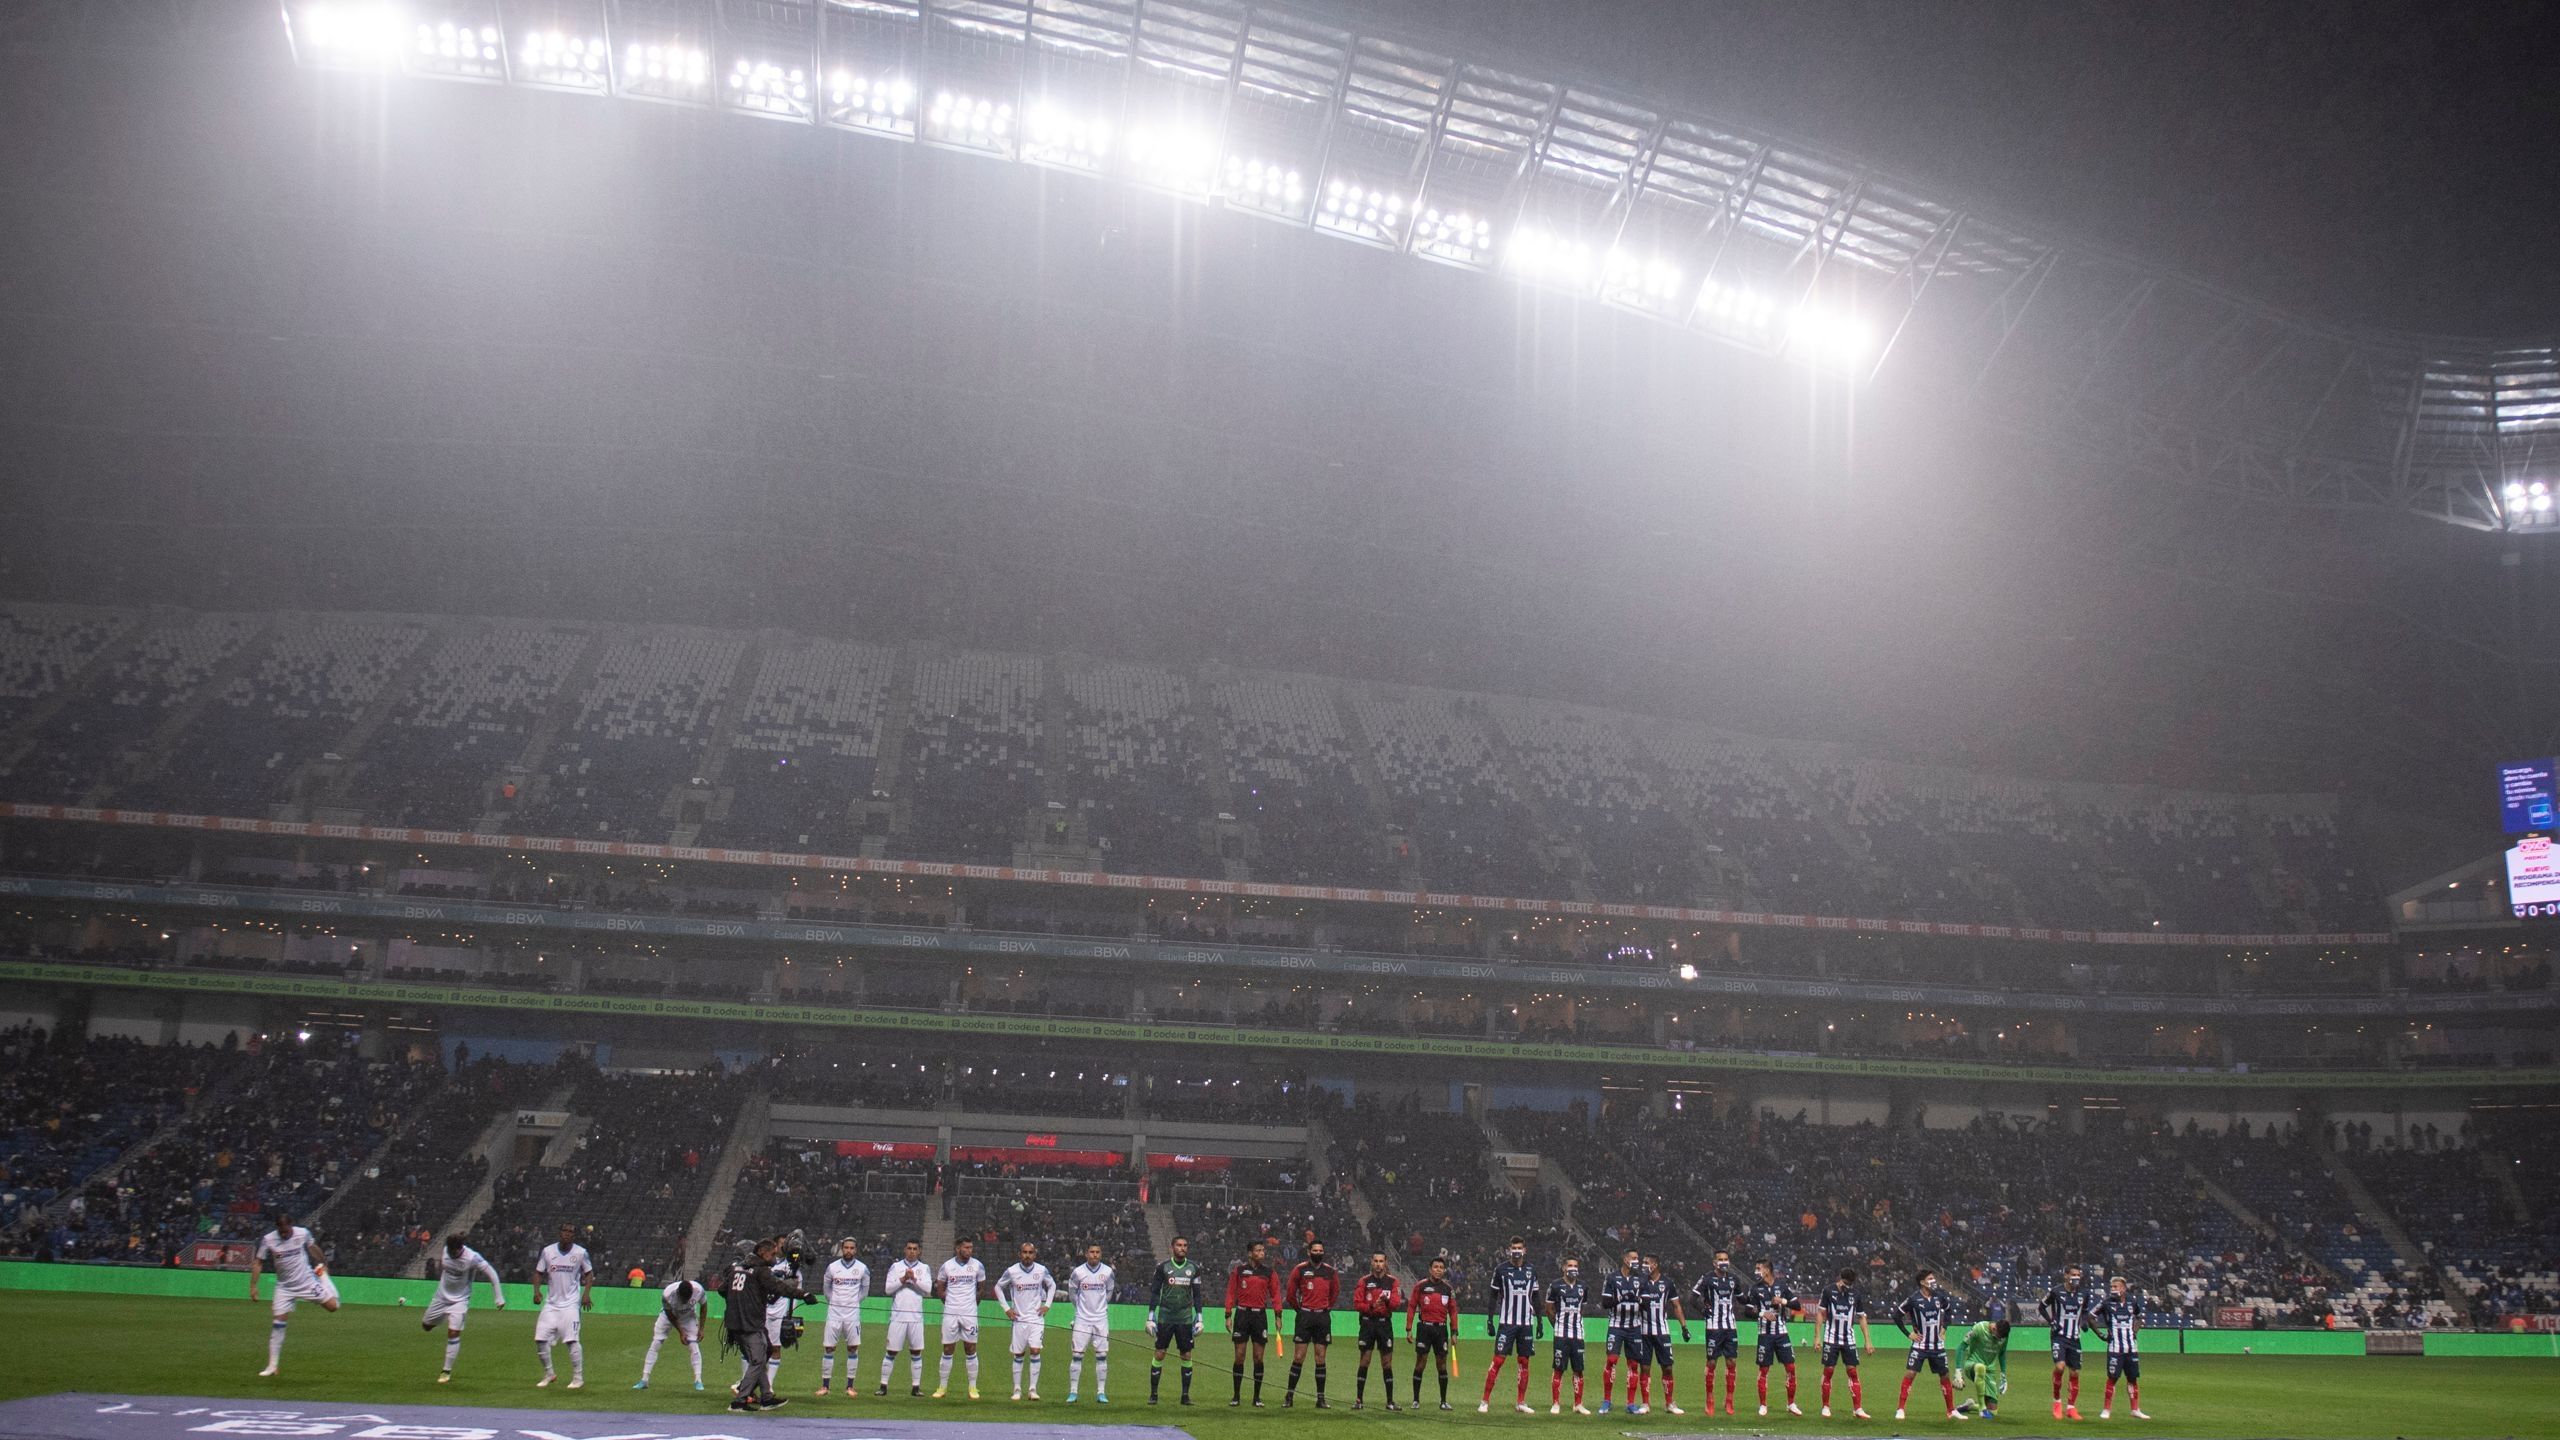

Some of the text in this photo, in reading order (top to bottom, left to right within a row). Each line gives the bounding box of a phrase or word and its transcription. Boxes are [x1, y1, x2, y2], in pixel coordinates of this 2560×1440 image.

[322, 823, 359, 838] TECATE
[372, 826, 408, 841] TECATE
[423, 829, 460, 844] TECATE
[474, 833, 510, 847] TECATE
[525, 836, 561, 850] TECATE
[574, 839, 610, 853] TECATE
[624, 842, 660, 857] TECATE
[672, 845, 708, 860] TECATE
[723, 848, 760, 862] TECATE
[771, 852, 806, 866] TECATE
[821, 855, 857, 869] TECATE
[869, 858, 904, 872] TECATE
[918, 861, 952, 875] TECATE
[964, 864, 999, 879] TECATE
[1013, 867, 1048, 882] TECATE
[1059, 869, 1093, 884] TECATE
[1107, 872, 1141, 887] TECATE
[1153, 875, 1187, 889] TECATE
[94, 887, 135, 900] BBVA
[1200, 880, 1234, 894] TECATE
[1246, 882, 1280, 896] TECATE
[1293, 885, 1326, 898] TECATE
[199, 894, 240, 906] BBVA
[1336, 887, 1370, 901] TECATE
[1384, 890, 1417, 903] TECATE
[1427, 892, 1460, 906] TECATE
[302, 900, 342, 912] BBVA
[1472, 895, 1505, 909] TECATE
[1516, 897, 1549, 911] TECATE
[1560, 900, 1593, 913] TECATE
[404, 906, 445, 919] BBVA
[1602, 903, 1635, 916] TECATE
[1647, 905, 1680, 919] TECATE
[1688, 908, 1720, 921] TECATE
[506, 913, 545, 925] BBVA
[1733, 910, 1764, 924] TECATE
[1774, 912, 1805, 926] TECATE
[1816, 915, 1848, 928] TECATE
[607, 918, 645, 931] BBVA
[706, 924, 745, 936] BBVA
[1857, 917, 1888, 931] TECATE
[1900, 920, 1931, 933] TECATE
[1939, 922, 1970, 935] TECATE
[1981, 924, 2011, 937] TECATE
[804, 929, 843, 942] BBVA
[2020, 927, 2050, 940] TECATE
[902, 935, 940, 947] BBVA
[999, 940, 1036, 952] BBVA
[1093, 946, 1131, 958] BBVA
[1188, 951, 1224, 963] BBVA
[1280, 957, 1316, 968] BBVA
[1372, 961, 1407, 973] BBVA
[1461, 966, 1496, 978] BBVA
[1552, 971, 1585, 983] BBVA
[1639, 976, 1672, 988] BBVA
[1724, 981, 1758, 993] BBVA
[305, 984, 339, 994] codere
[359, 987, 395, 997] codere
[407, 990, 443, 1000] codere
[1809, 985, 1841, 997] BBVA
[1892, 990, 1924, 1001] BBVA
[462, 993, 496, 1003] codere
[510, 996, 545, 1005] codere
[565, 999, 599, 1009] codere
[1974, 994, 2006, 1006] BBVA
[2054, 997, 2086, 1009] BBVA
[613, 1002, 646, 1011] codere
[666, 1005, 699, 1014] codere
[713, 1007, 747, 1016] codere
[766, 1010, 800, 1020] codere
[813, 1013, 846, 1022] codere
[864, 1015, 897, 1024] codere
[911, 1017, 944, 1027] codere
[962, 1020, 994, 1030] codere
[1008, 1022, 1040, 1032] codere
[1059, 1025, 1090, 1034] codere
[1104, 1027, 1136, 1037] codere
[1153, 1030, 1185, 1039] codere
[1198, 1033, 1230, 1042] codere
[1247, 1035, 1279, 1044] codere
[1292, 1037, 1323, 1046] codere
[1340, 1039, 1371, 1048] codere
[1384, 1041, 1415, 1050] codere
[732, 1273, 746, 1291] 28
[97, 1402, 392, 1423] LIGA
